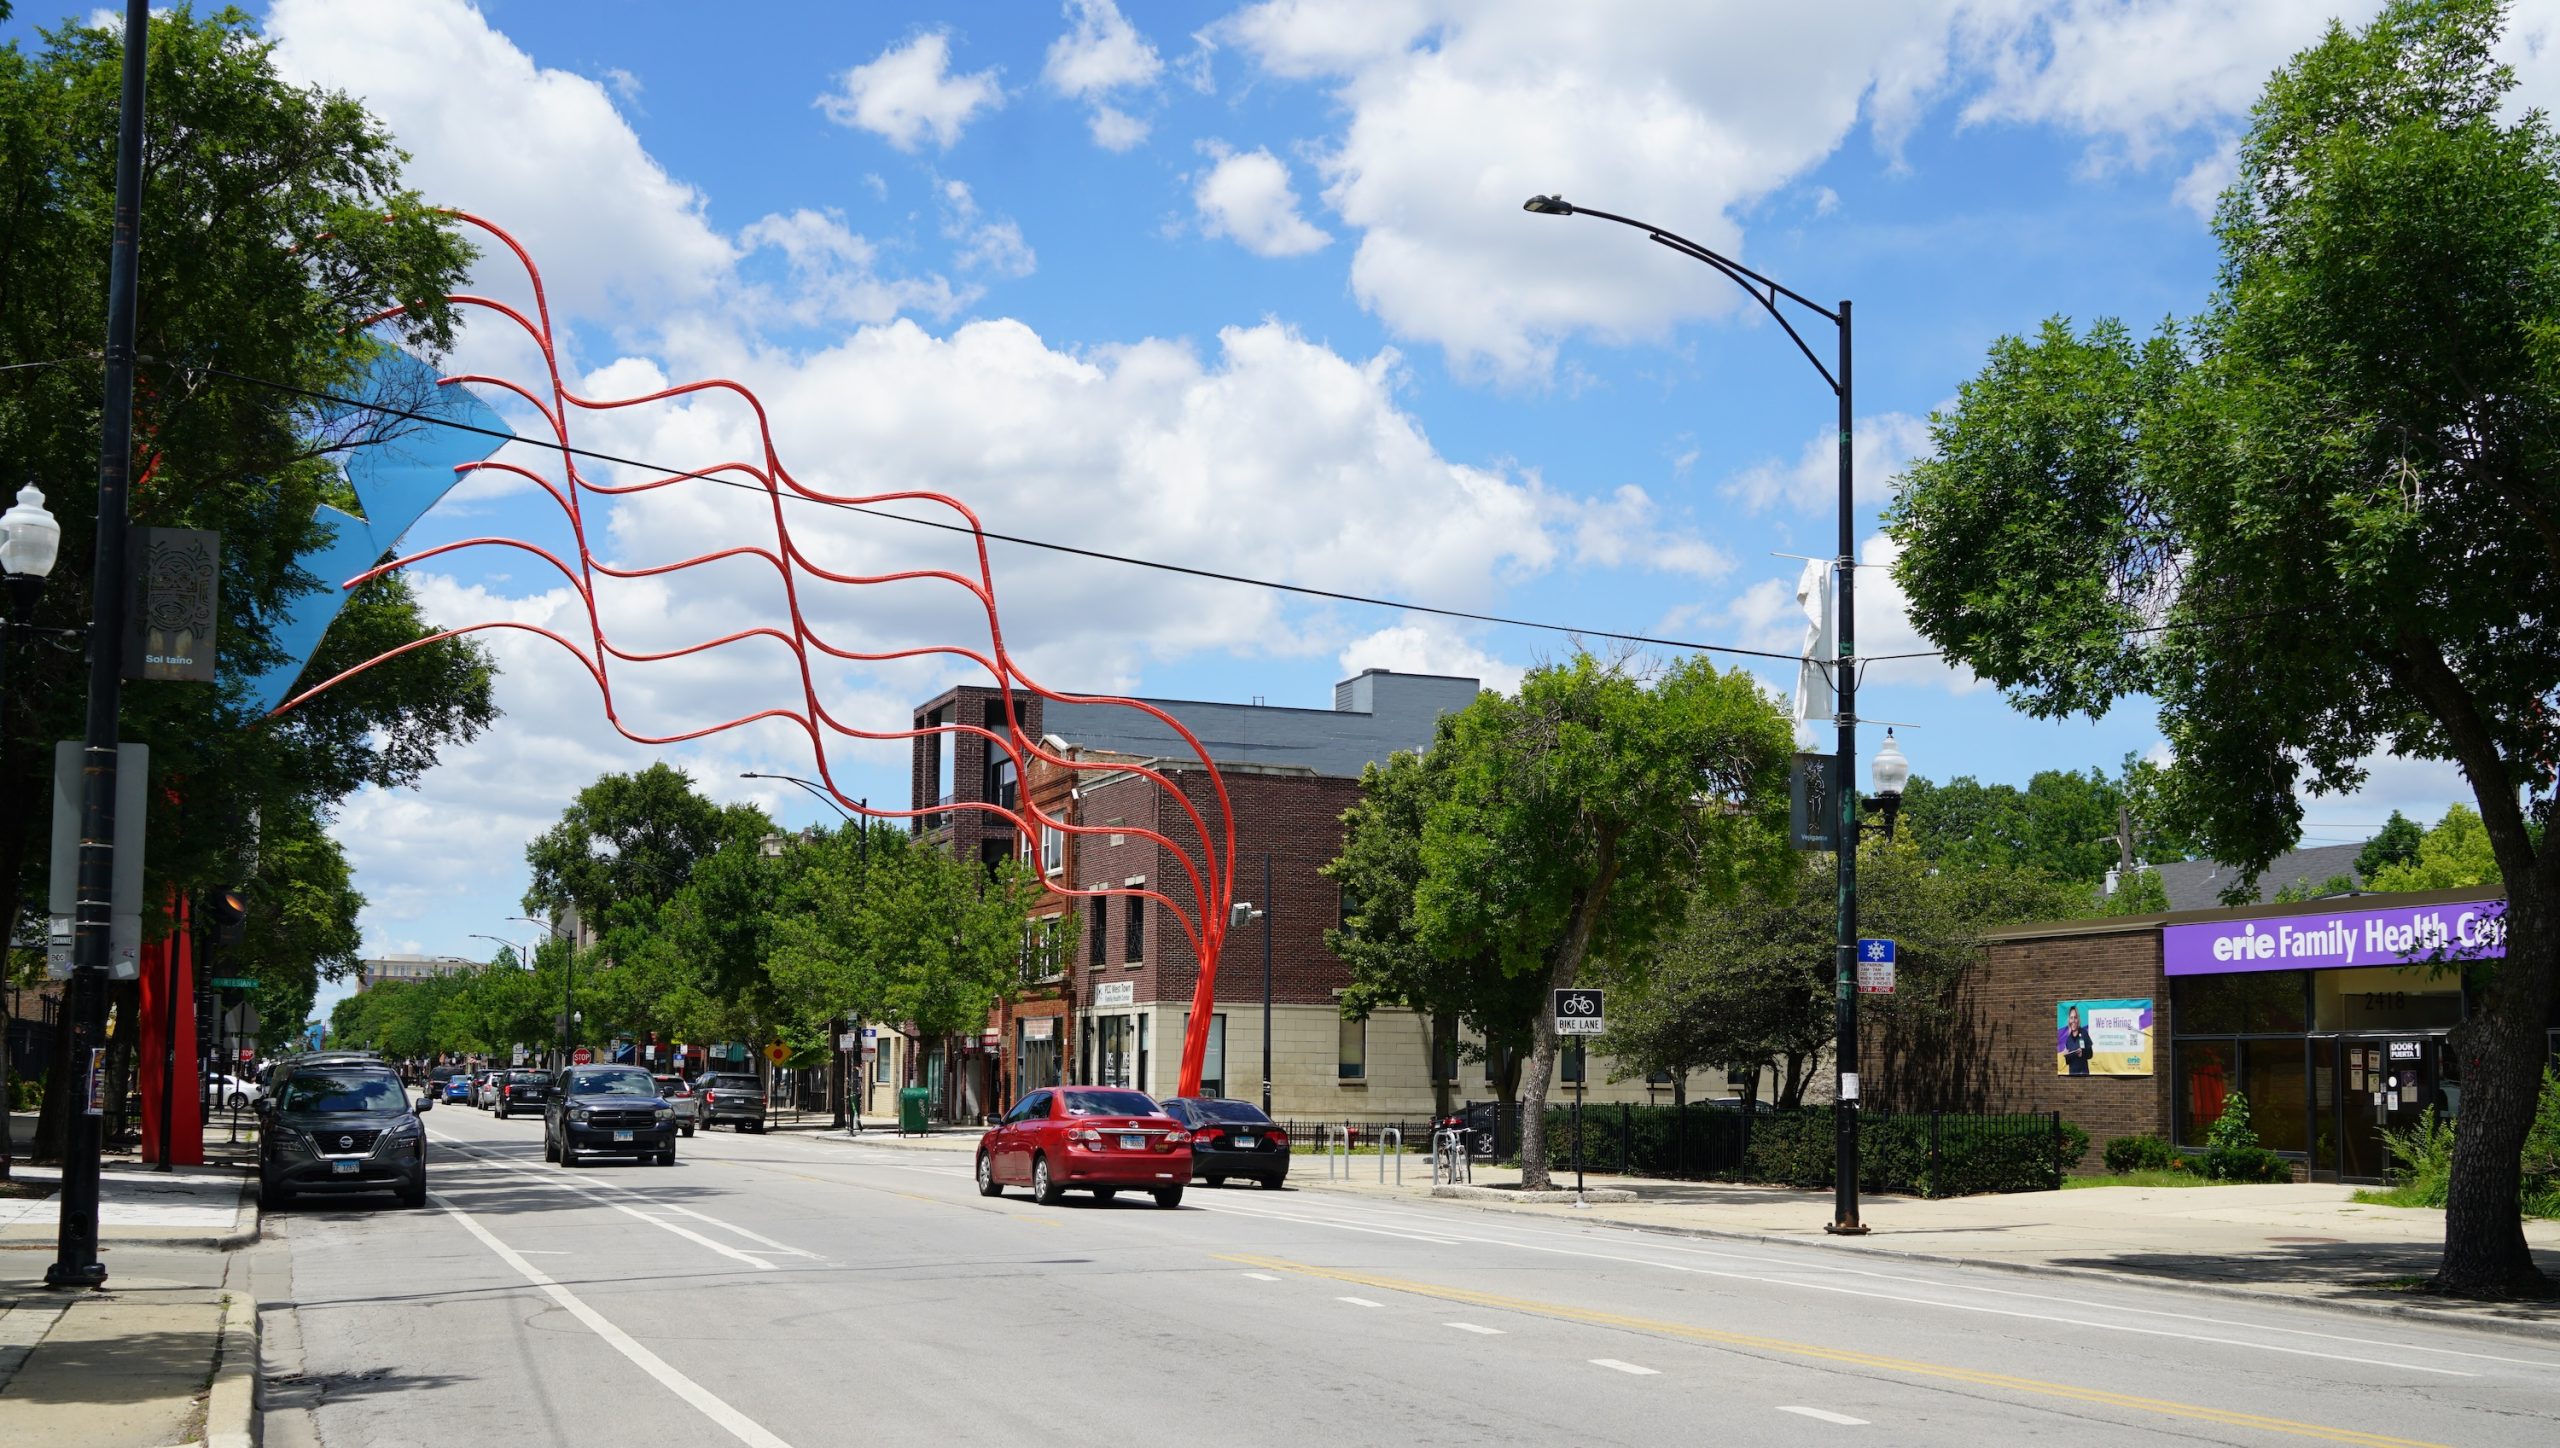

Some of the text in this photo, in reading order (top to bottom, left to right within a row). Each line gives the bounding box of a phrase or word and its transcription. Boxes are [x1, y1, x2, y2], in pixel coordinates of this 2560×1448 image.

[145, 654, 164, 664] Sol
[2213, 923, 2275, 961] erie
[2279, 919, 2358, 963] Family
[2365, 912, 2448, 952] Health
[2365, 991, 2405, 1010] 2418
[1560, 1020, 1600, 1029] BIKE LANE
[2095, 1016, 2132, 1030] We're Hiring
[2391, 1042, 2420, 1057] DOOR 1
[574, 1053, 591, 1061] STOP
